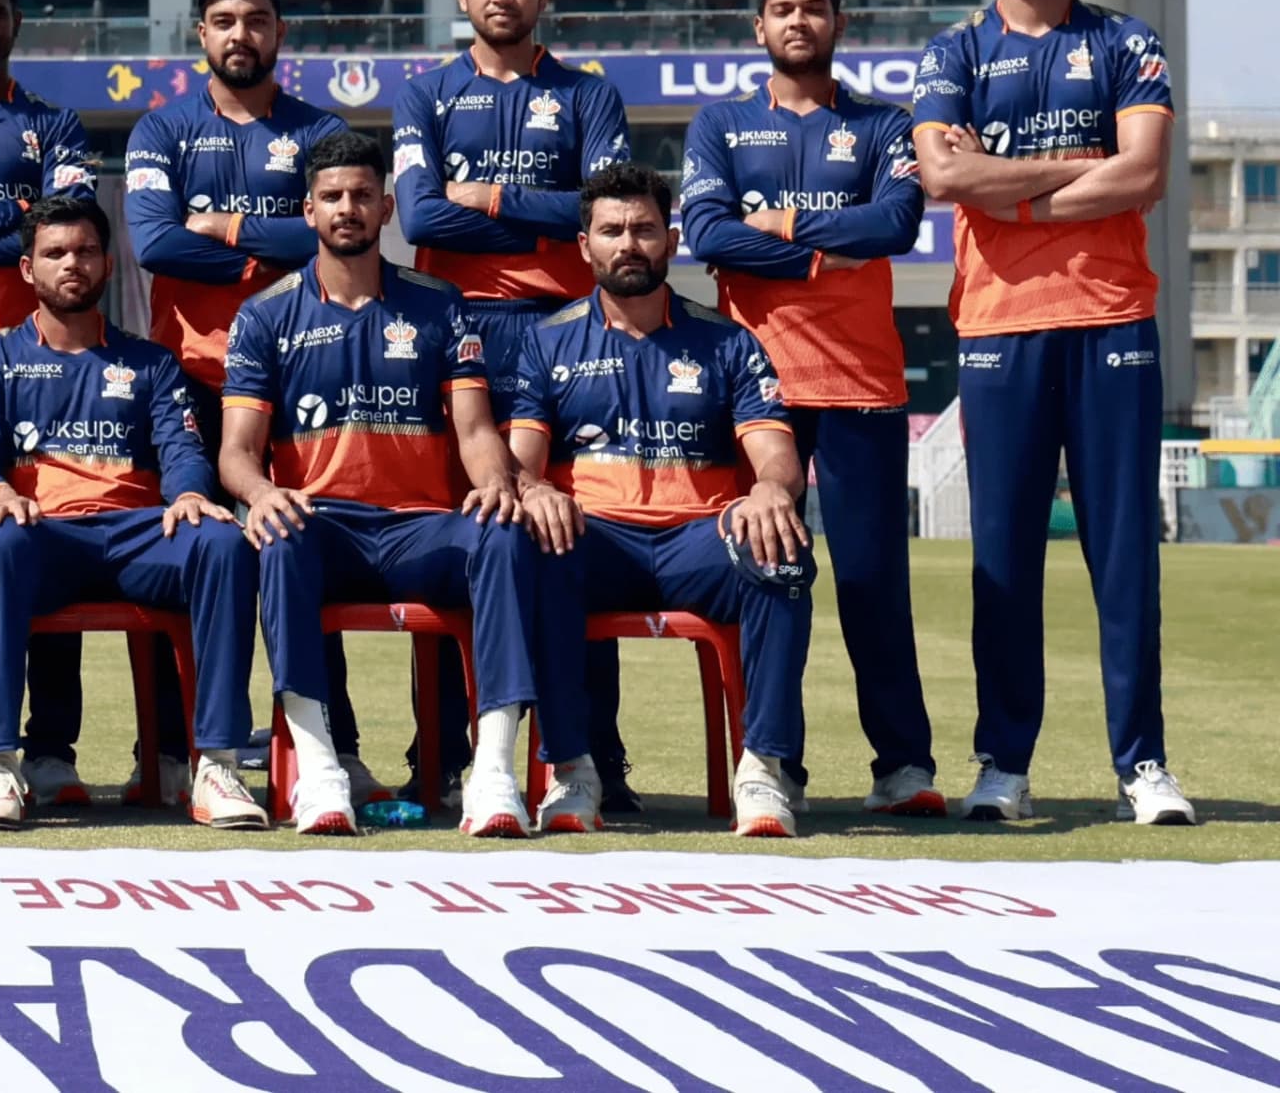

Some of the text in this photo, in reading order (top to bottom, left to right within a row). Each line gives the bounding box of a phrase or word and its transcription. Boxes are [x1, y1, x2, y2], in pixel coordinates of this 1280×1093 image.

[778, 564, 803, 577] SPSU
[0, 878, 375, 912] CHANGE
[375, 880, 504, 913] IT.
[489, 882, 1056, 918] CHALLENGE
